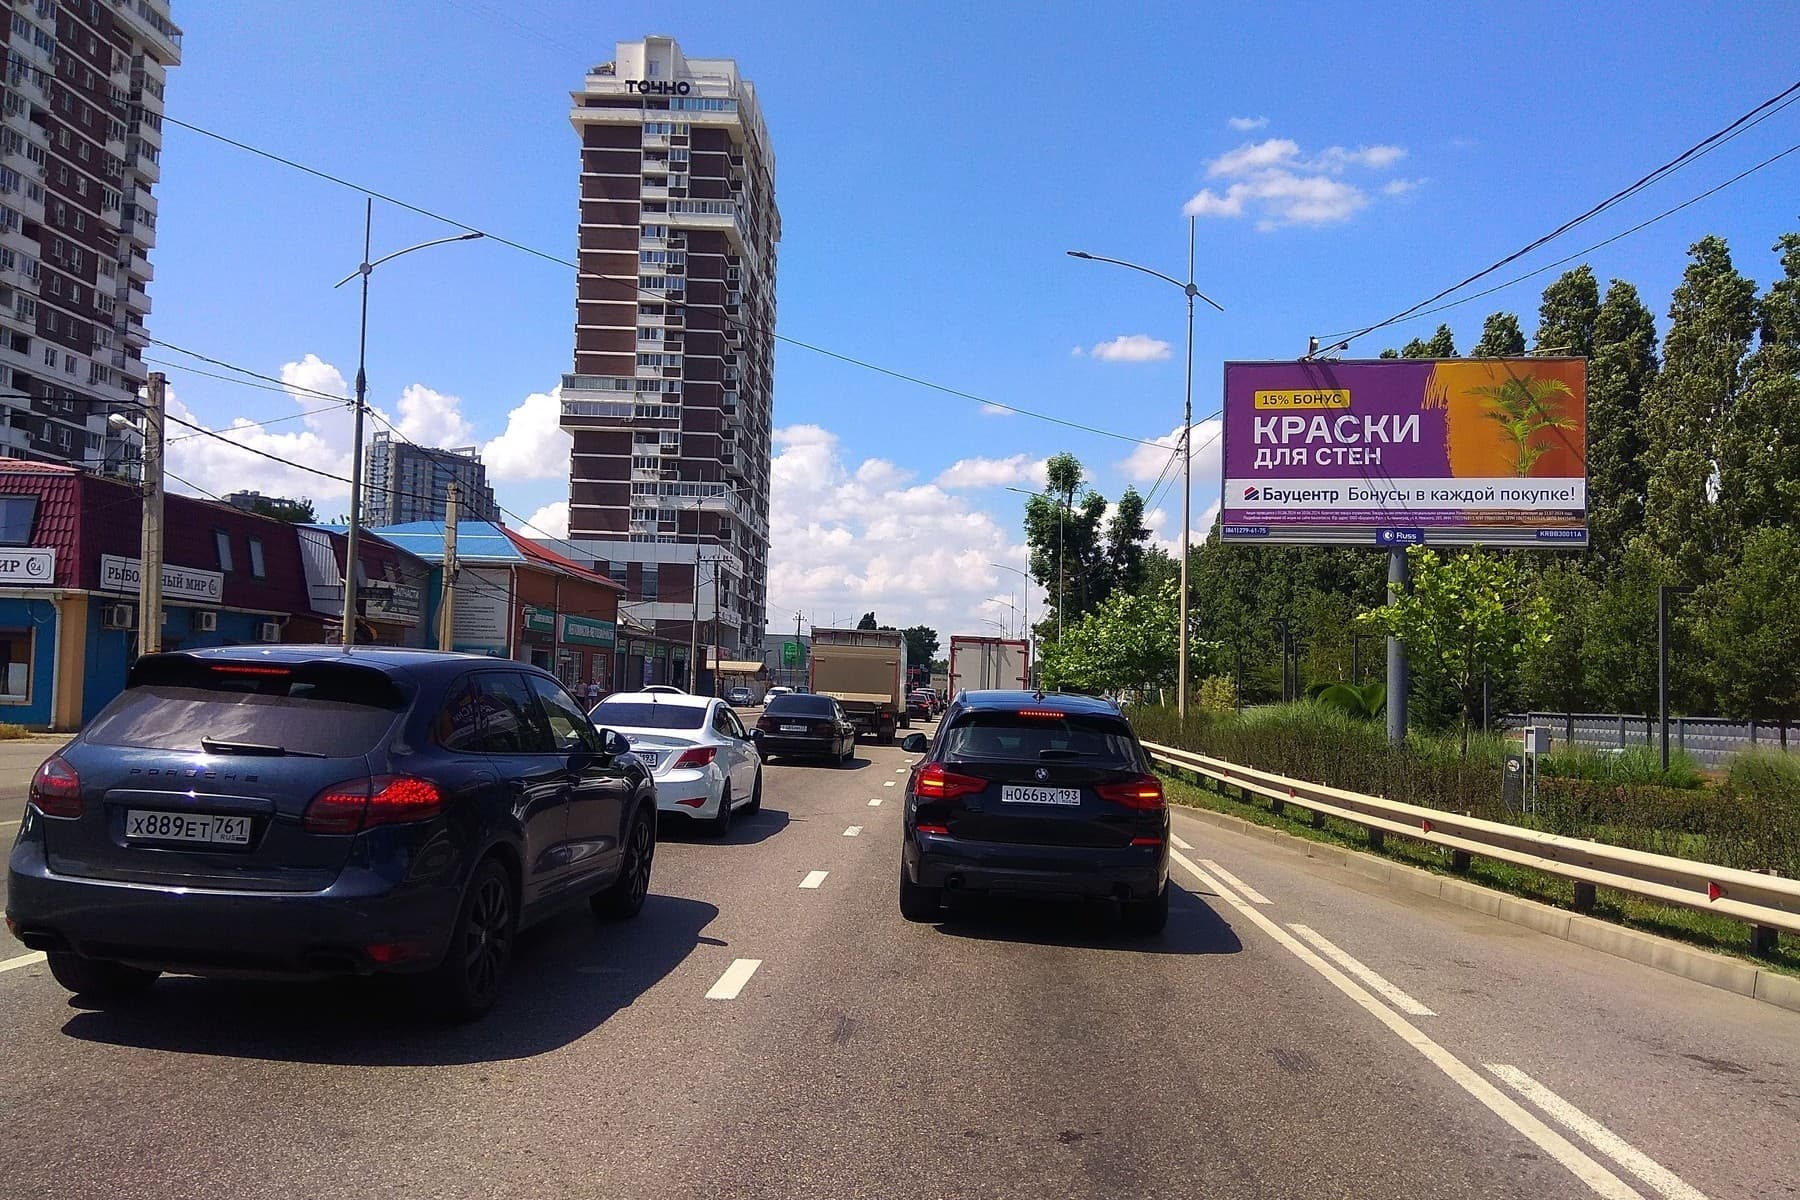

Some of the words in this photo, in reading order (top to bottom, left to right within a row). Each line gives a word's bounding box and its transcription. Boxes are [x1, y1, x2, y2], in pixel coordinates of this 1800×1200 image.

[625, 80, 690, 95] ТОЧНО
[1262, 395, 1289, 405] 15%
[1293, 394, 1342, 405] БОНУС
[1254, 415, 1420, 444] КРАСКИ
[1254, 448, 1307, 469] ДЛЯ
[1315, 448, 1381, 466] СТЕН
[1263, 487, 1339, 503] Бауцентр
[1348, 487, 1410, 504] Бонусы
[1416, 490, 1425, 501] в
[1430, 487, 1495, 502] каждой
[1500, 486, 1575, 504] покупке!
[1396, 532, 1417, 540] Russ
[108, 566, 183, 589] РЫБОНЫЙ
[186, 578, 207, 591] МИР
[130, 768, 259, 782] PORSCHE
[1058, 790, 1078, 800] 193
[215, 817, 245, 835] 761
